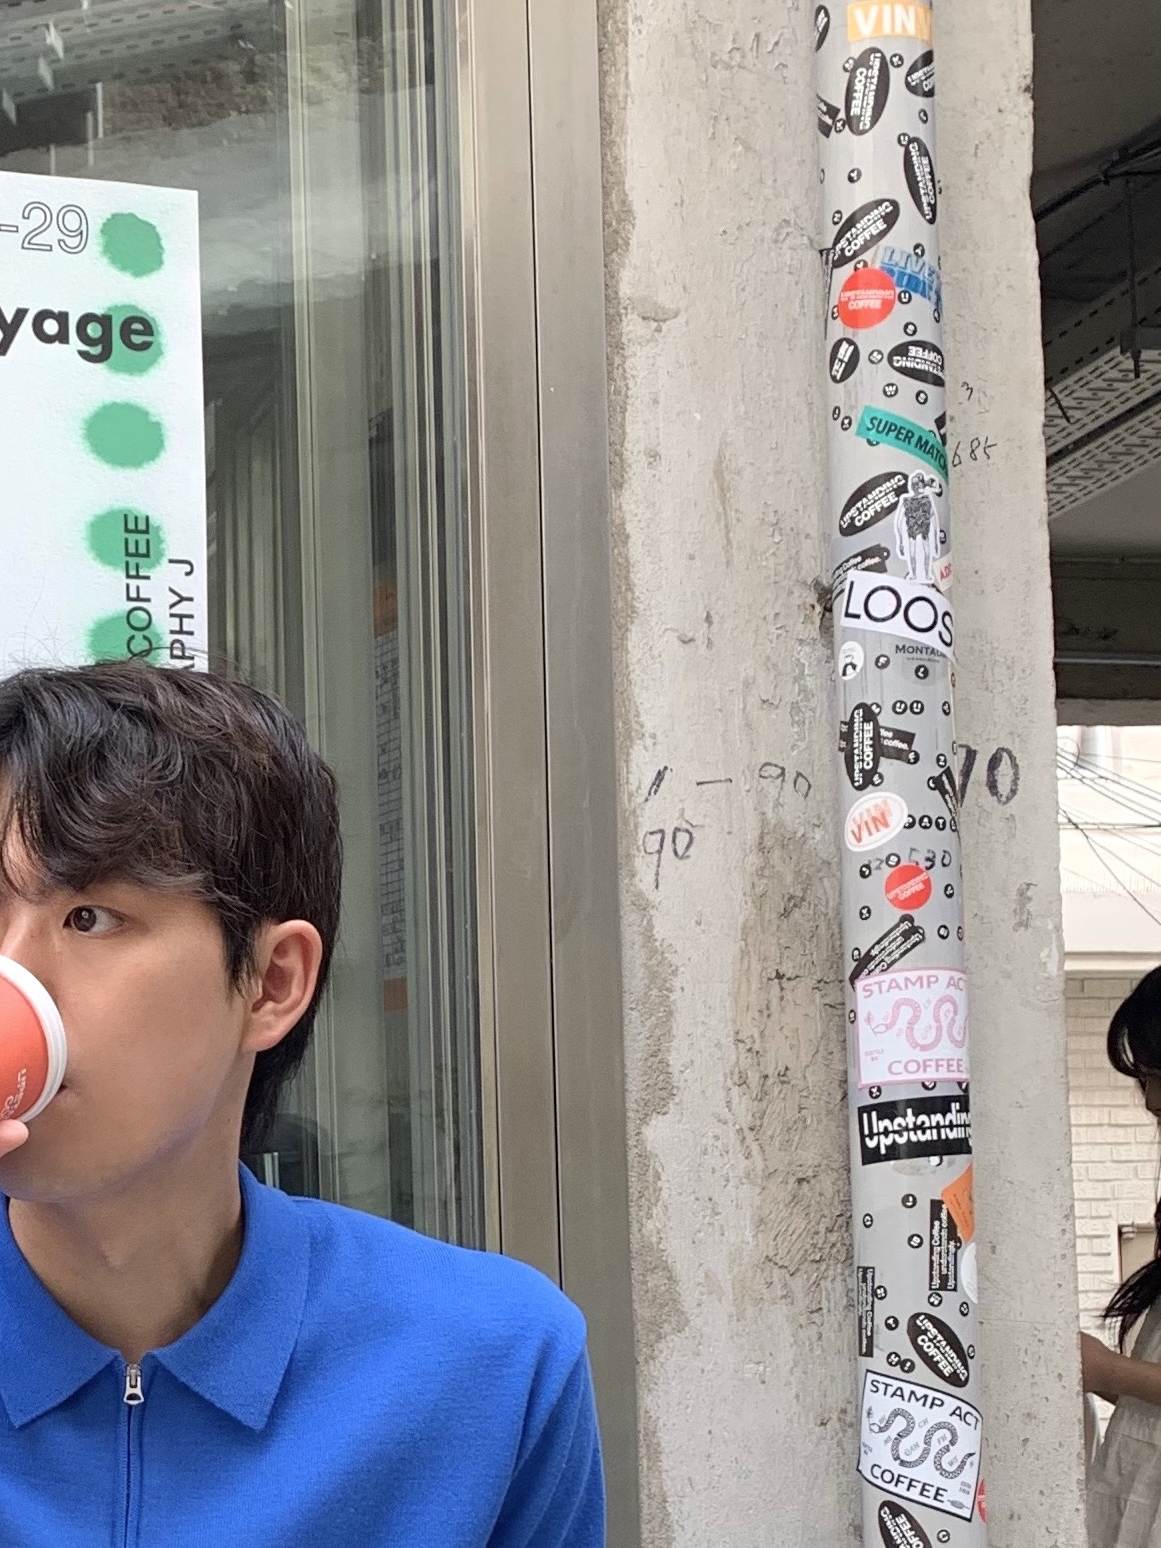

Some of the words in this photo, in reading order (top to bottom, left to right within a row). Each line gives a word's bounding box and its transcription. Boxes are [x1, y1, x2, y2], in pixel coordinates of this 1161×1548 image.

[851, 68, 867, 117] COFFEE
[844, 219, 887, 257] COFFEE
[865, 416, 915, 445] SUPER
[840, 474, 906, 529] UPSTANDING
[854, 489, 899, 526] COFFEE
[124, 513, 154, 660] COFFEE
[168, 558, 194, 577] J
[169, 586, 196, 671] PHY
[863, 721, 874, 770] COFFEE
[862, 975, 939, 999] STAMP
[946, 976, 966, 991] AC
[887, 1058, 965, 1076] COFFEE
[863, 1103, 971, 1154] Upstandin
[916, 1315, 968, 1381] UPSTANDING
[917, 1335, 953, 1377] COFFEE
[870, 1379, 945, 1410] STAMP
[949, 1406, 981, 1430] ACT
[870, 1464, 948, 1503] COFFEE
